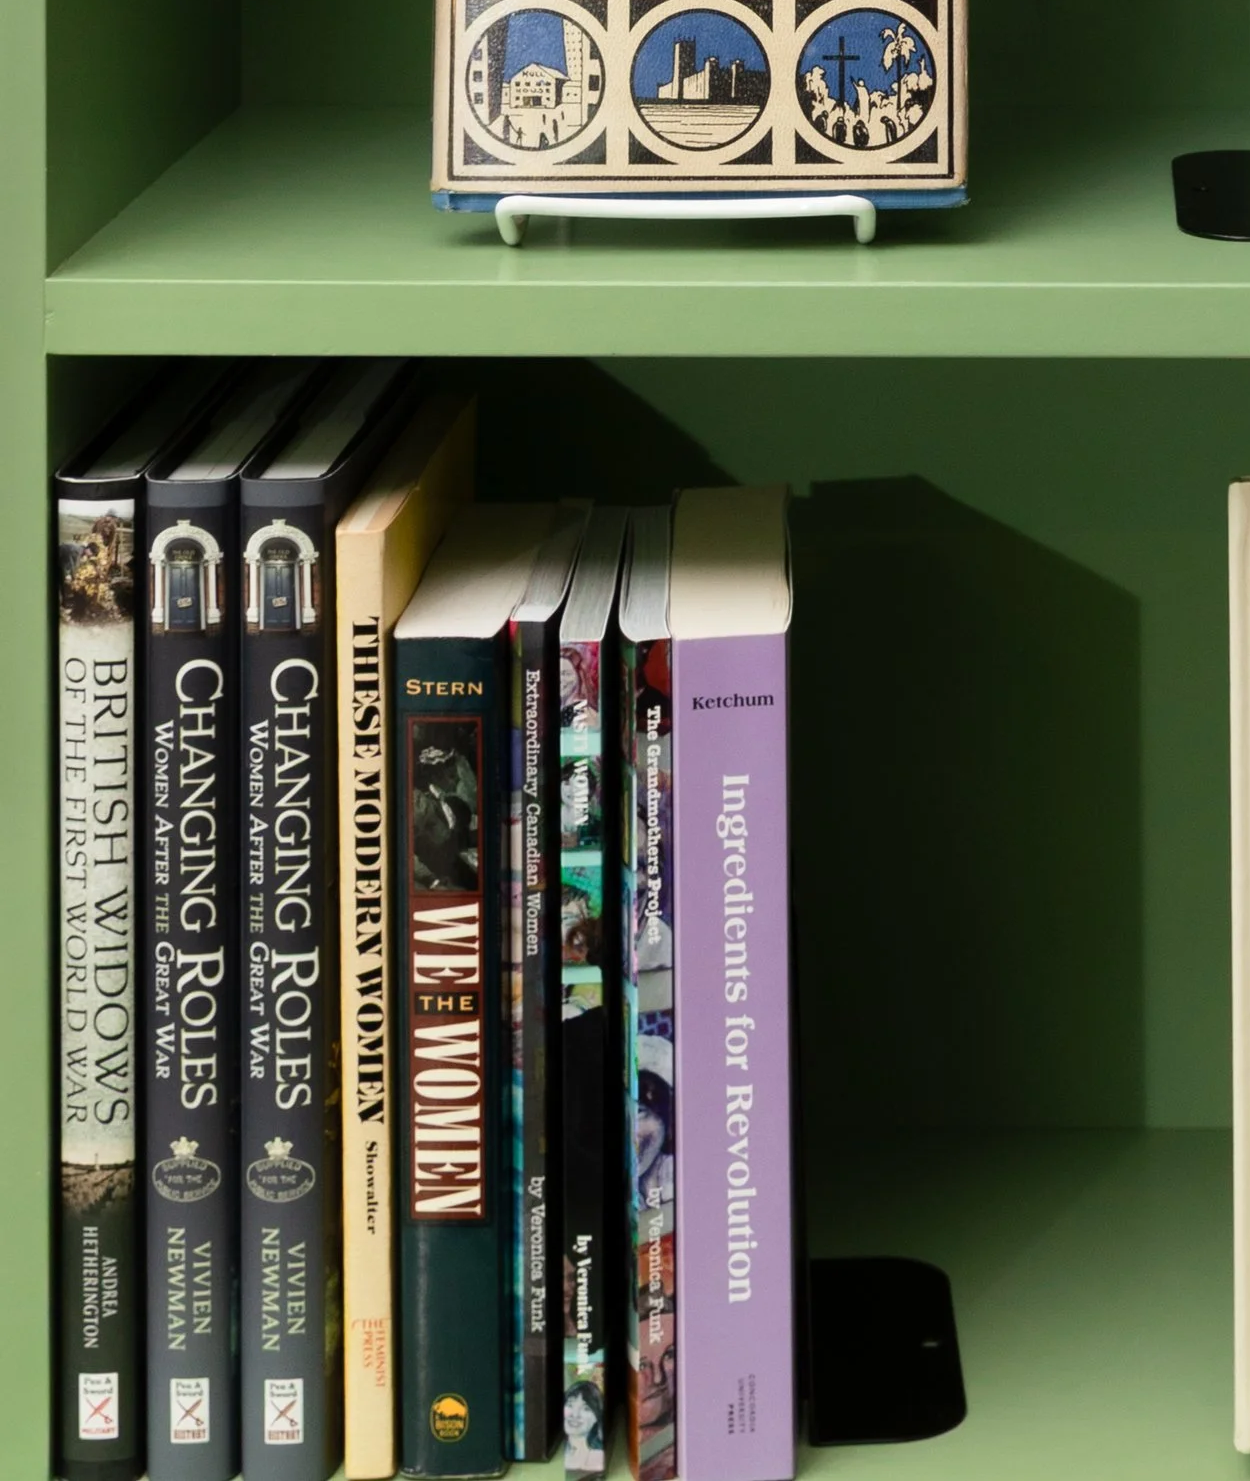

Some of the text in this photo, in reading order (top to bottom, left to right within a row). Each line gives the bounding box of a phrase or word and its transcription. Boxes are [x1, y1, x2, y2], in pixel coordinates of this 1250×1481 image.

[692, 693, 774, 710] Ketchum
[154, 720, 174, 808] WOMEN
[525, 669, 542, 956] Extraordinary Canadian Women
[64, 657, 89, 1124] OF THE FIRST WORLD WAR
[92, 658, 129, 1126] BRITISH WIDOWS
[155, 892, 170, 934] THE
[351, 616, 385, 1125] THESE MODERN WOMEN
[155, 940, 182, 1016] GREAT
[413, 901, 480, 985] WE
[419, 995, 474, 1011] THE
[716, 773, 758, 1304] Ingredients for Revolution
[155, 1022, 175, 1080] WAR
[414, 1018, 481, 1216] WOMEN
[365, 1141, 379, 1236] Showalter
[82, 1226, 99, 1349] HETHERINGTON
[101, 1256, 117, 1319] ANDREA
[168, 1227, 186, 1350] NEWMAN
[192, 1241, 212, 1334] VIVIEN
